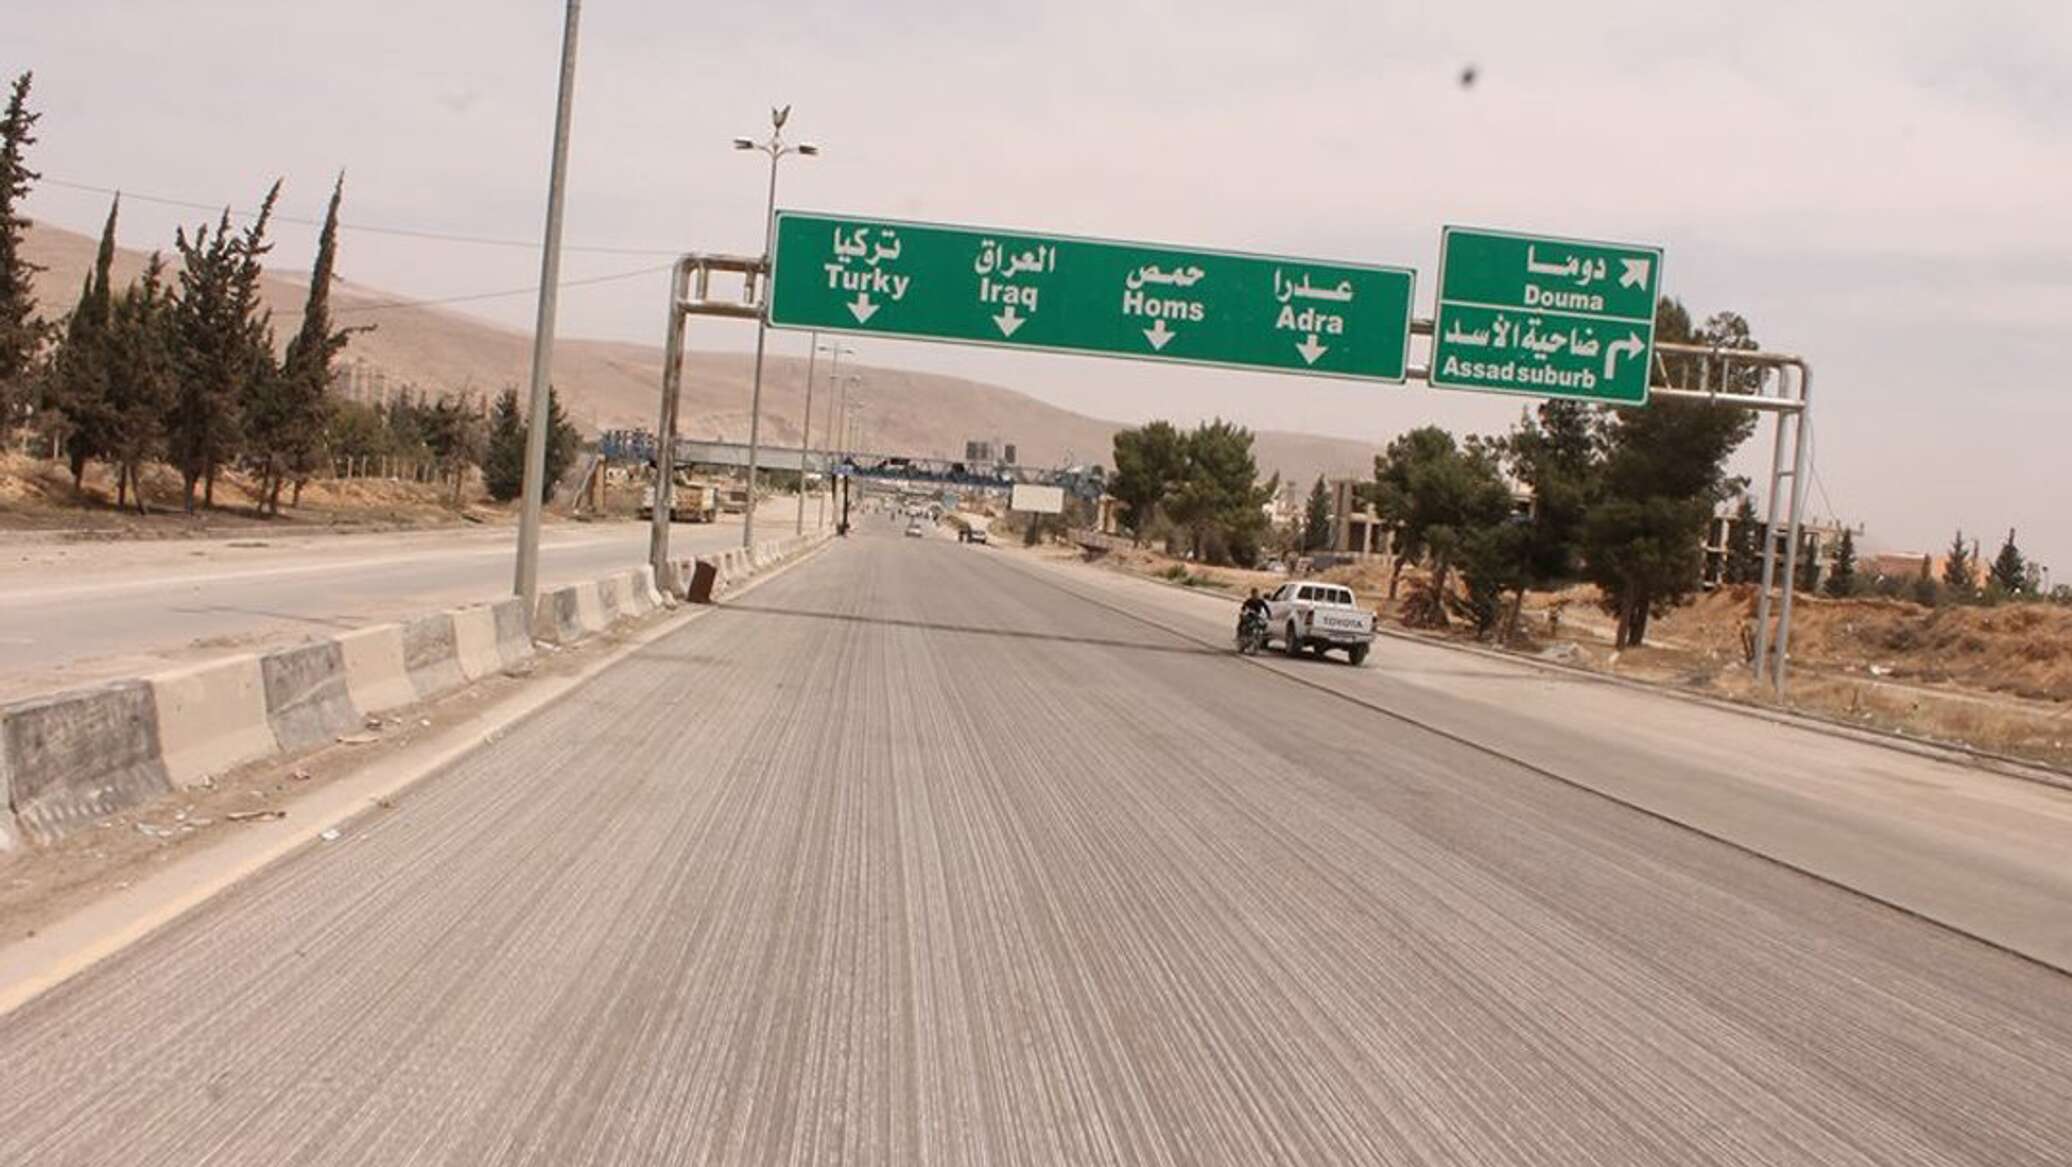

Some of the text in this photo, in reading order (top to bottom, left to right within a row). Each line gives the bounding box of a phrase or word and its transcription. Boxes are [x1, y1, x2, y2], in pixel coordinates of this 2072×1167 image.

[834, 226, 901, 265] تركيا
[974, 237, 1056, 278] العراق
[825, 263, 909, 300] Turky
[1126, 261, 1206, 289] حمص
[1526, 244, 1607, 286] دوما
[980, 278, 1038, 312] Iraq
[1273, 266, 1354, 303] عدرا
[1524, 284, 1604, 311] Douma
[1123, 291, 1205, 321] Homs
[1276, 305, 1343, 334] Adra
[1521, 317, 1601, 361] ضاحية
[1443, 355, 1596, 390] Assad suburb
[1323, 616, 1363, 628] TOYOTA
